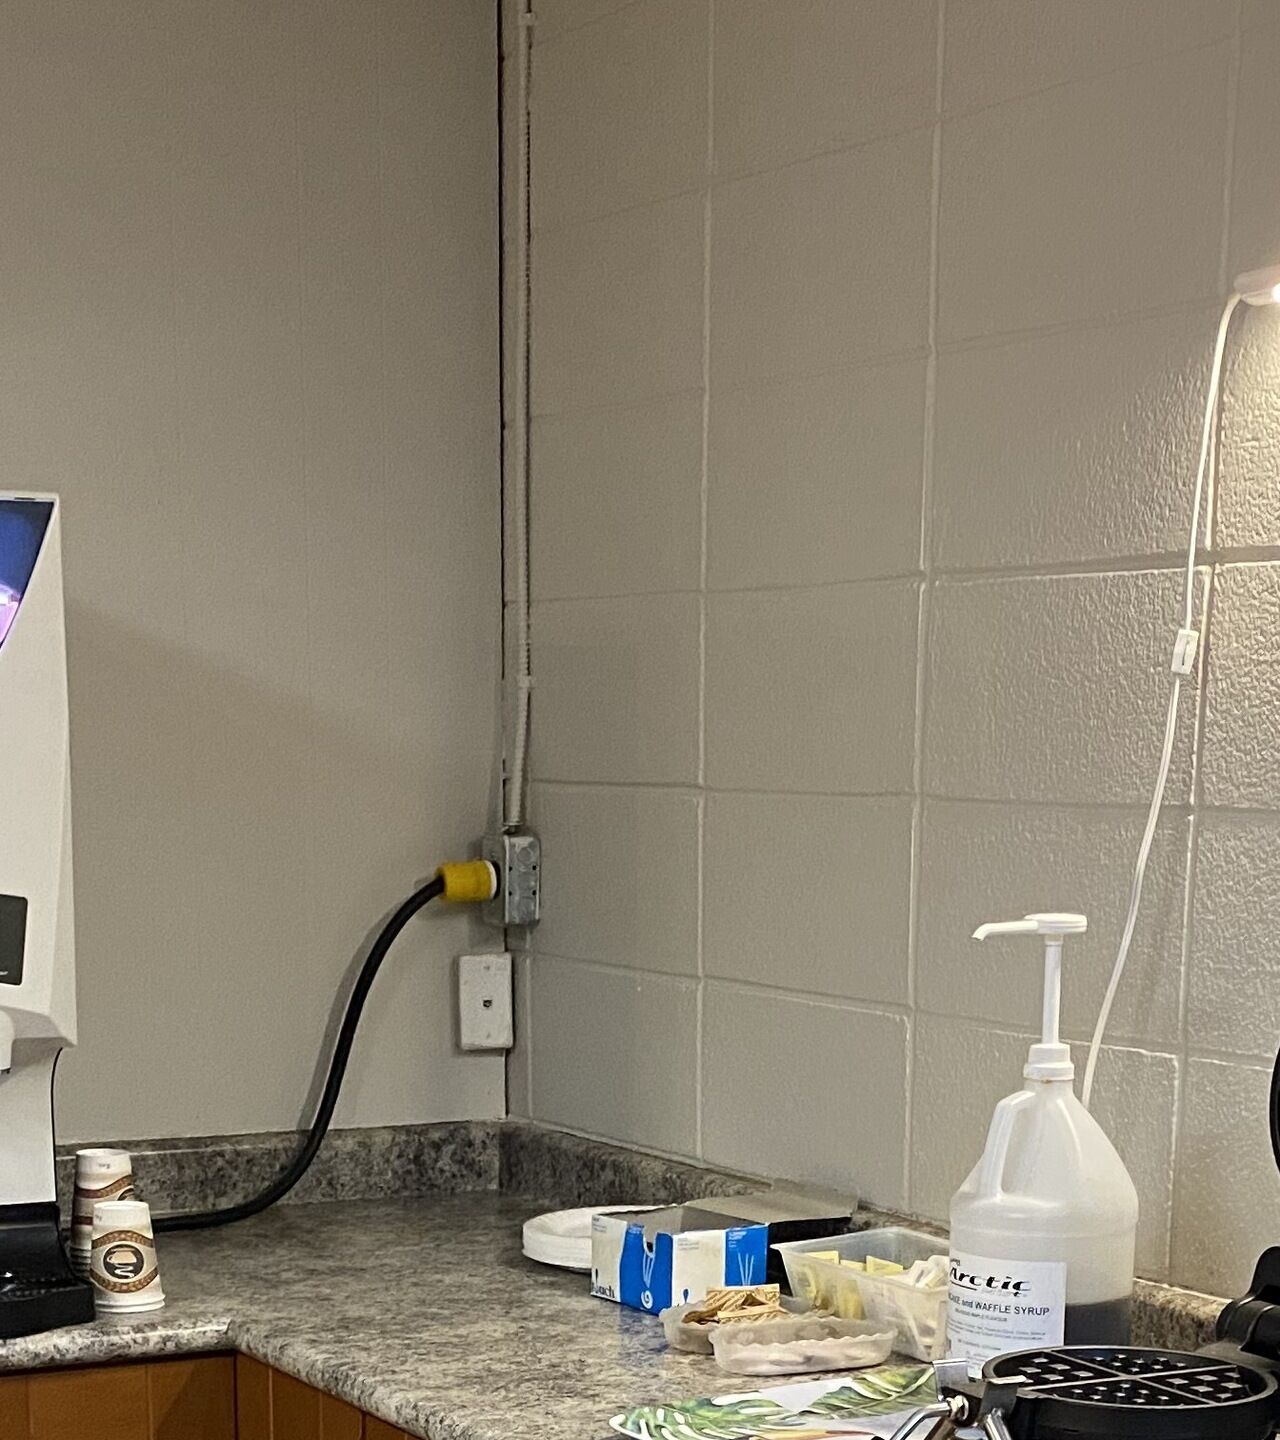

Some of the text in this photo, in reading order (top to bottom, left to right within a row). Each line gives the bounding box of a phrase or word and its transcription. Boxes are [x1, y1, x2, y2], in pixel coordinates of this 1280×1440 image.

[949, 1266, 1032, 1297] Arctic
[975, 1301, 1011, 1315] WAFFLE
[1014, 1305, 1051, 1317] SYRUP
